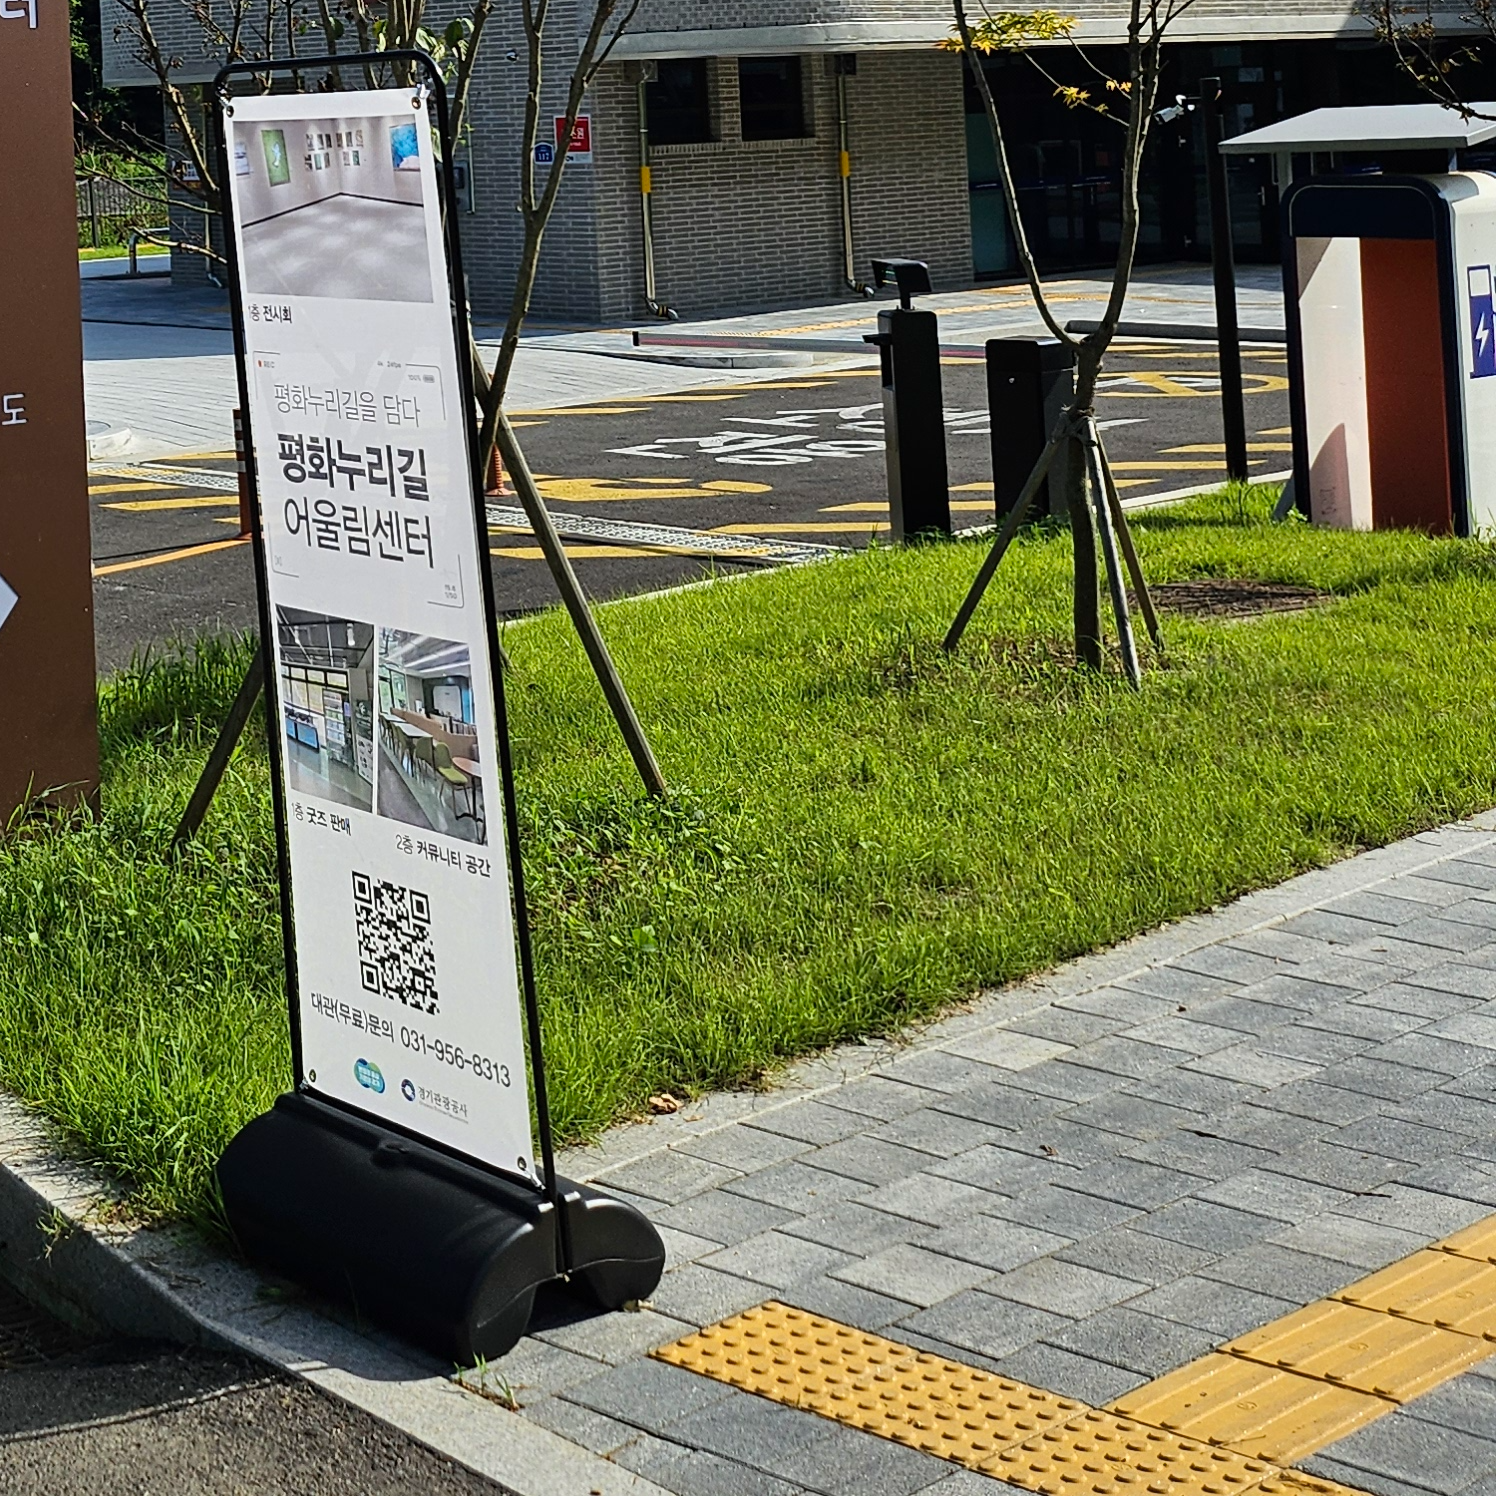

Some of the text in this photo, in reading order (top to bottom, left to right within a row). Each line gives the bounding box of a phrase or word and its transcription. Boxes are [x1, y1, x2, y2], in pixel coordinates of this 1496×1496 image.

[263, 305, 292, 324] 전시회
[274, 383, 421, 428] 평화누리길을 담다
[277, 433, 430, 502] 평화누리길
[284, 497, 434, 569] 어울림센터
[291, 802, 352, 837] 1층 굿즈 판매
[395, 834, 492, 878] 2층 커뮤니티 공간
[311, 992, 512, 1088] 대관(무료)문의 031-956-8313
[417, 1085, 468, 1117] 경기관광공사
